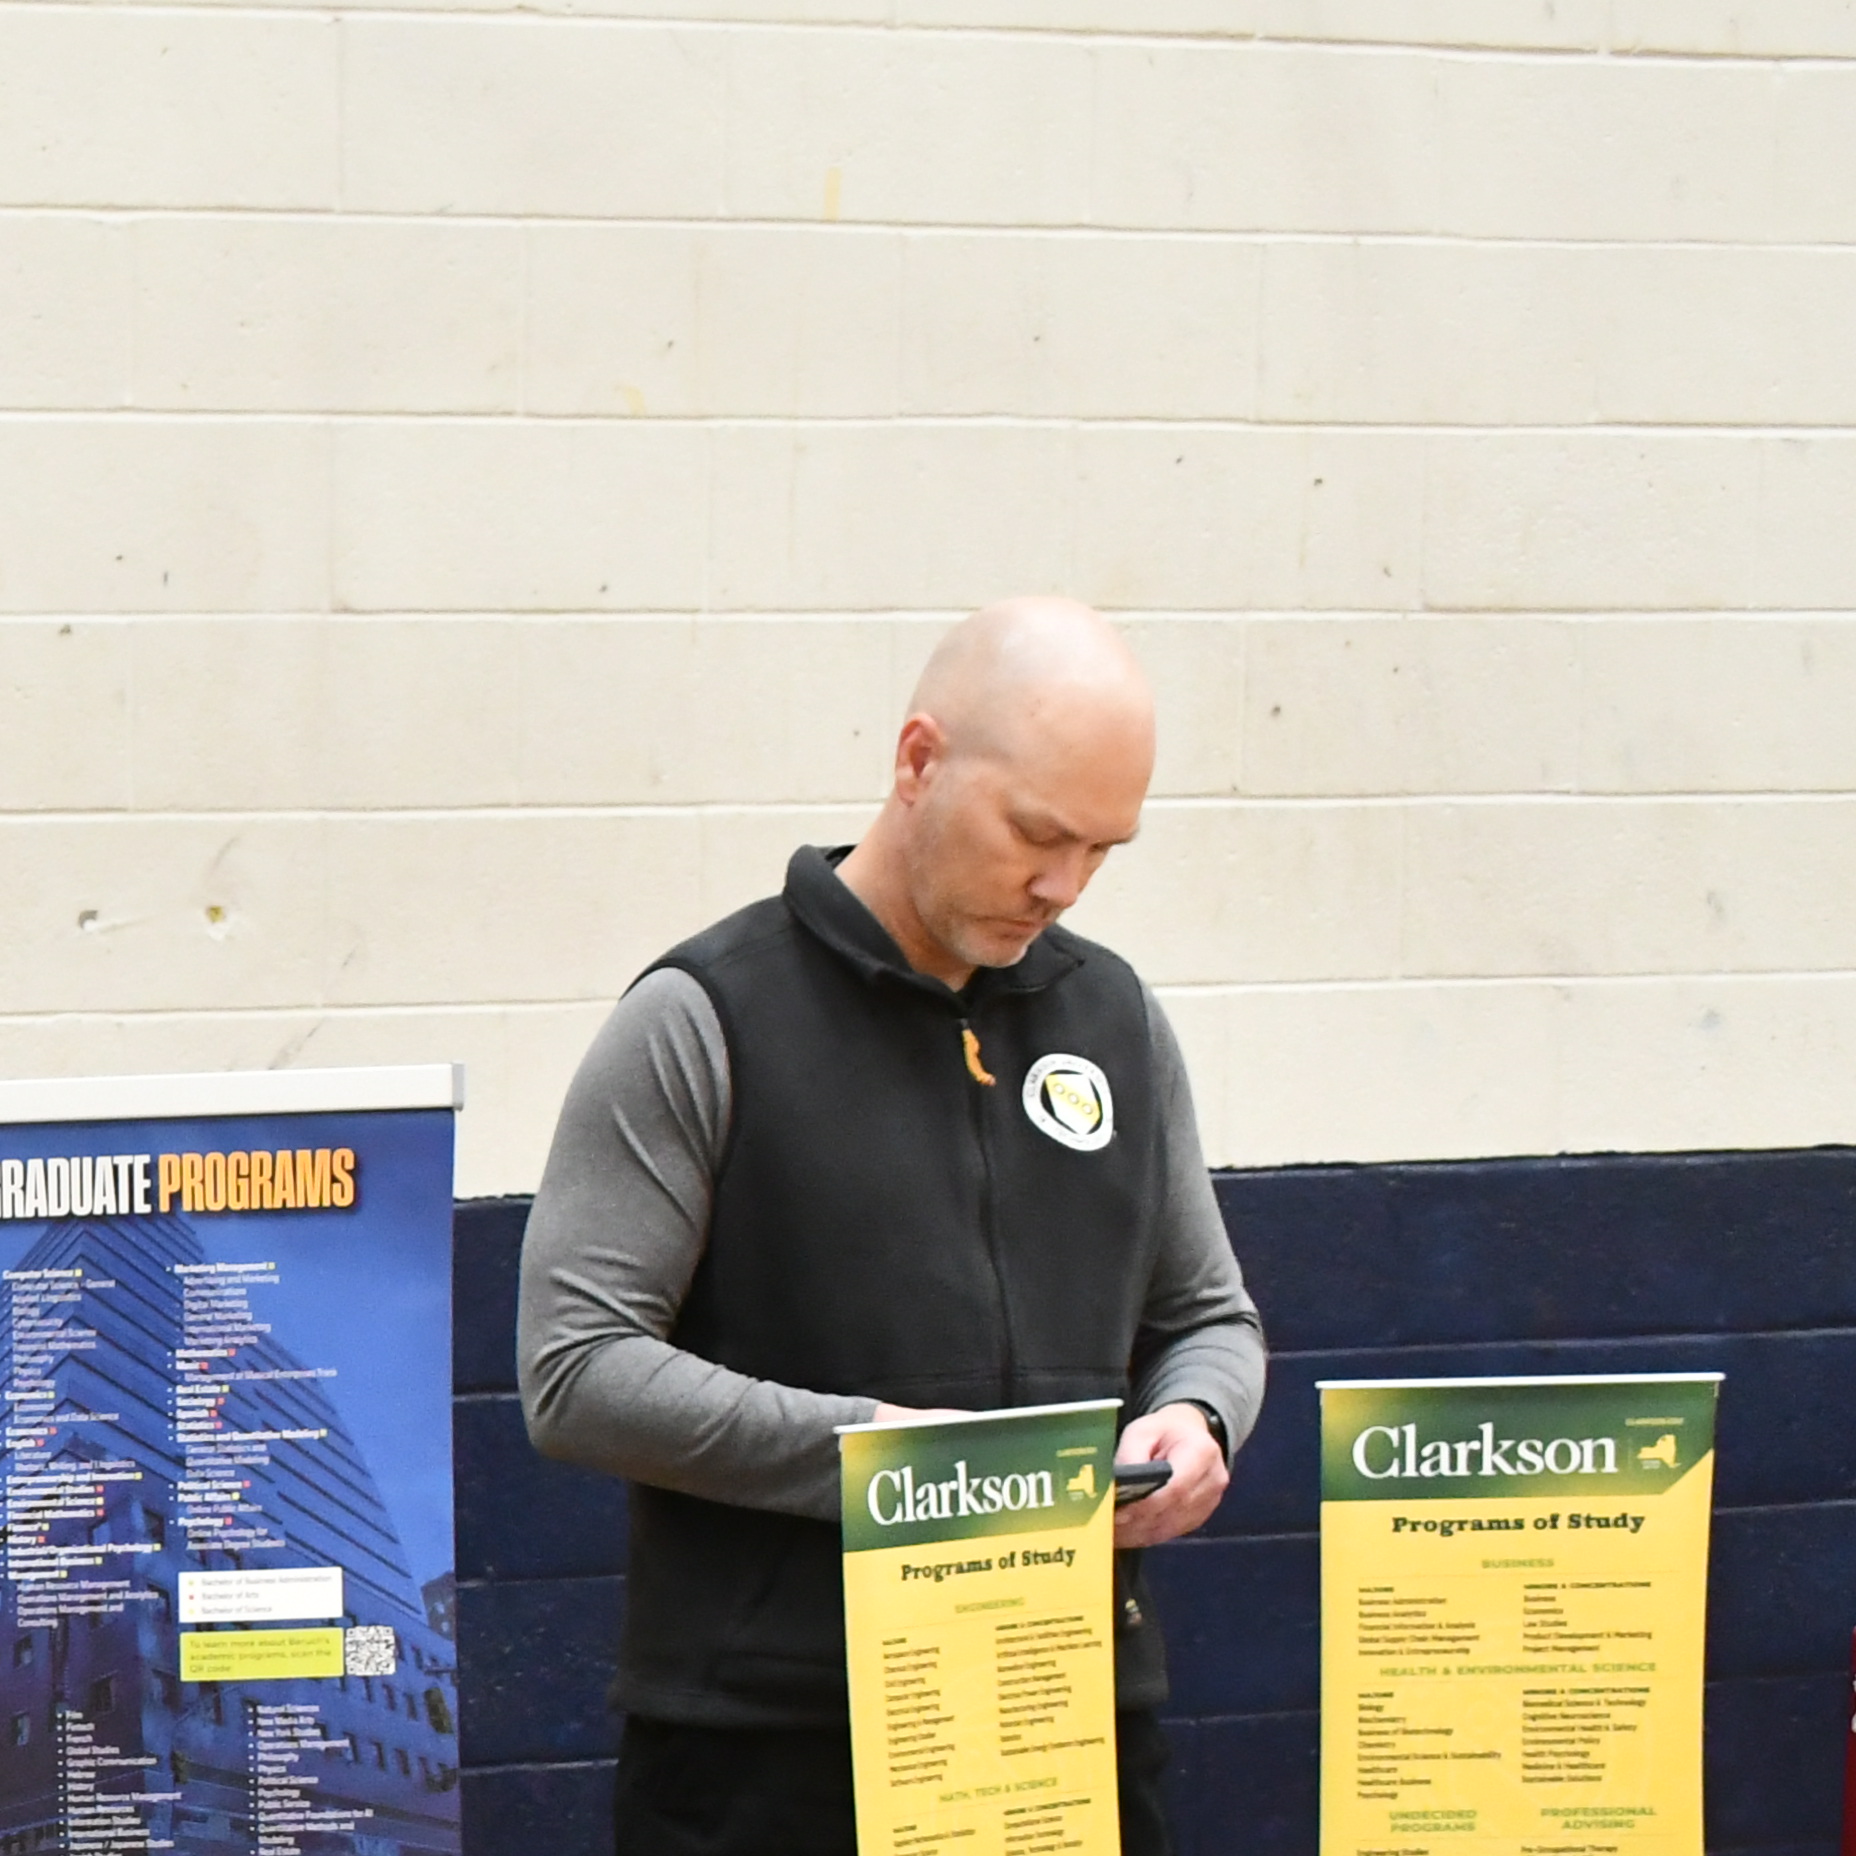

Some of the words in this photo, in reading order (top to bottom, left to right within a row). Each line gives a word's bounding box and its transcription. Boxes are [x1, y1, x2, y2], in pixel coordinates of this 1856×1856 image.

[158, 1147, 355, 1214] PROGRAMS
[1352, 1421, 1619, 1479] Clarkson
[867, 1460, 1055, 1525] Clarkson
[1392, 1516, 1525, 1537] Programs
[1533, 1513, 1560, 1530] of
[1568, 1512, 1645, 1534] Study
[901, 1558, 993, 1582] Programs
[999, 1551, 1016, 1570] of
[1022, 1546, 1076, 1567] Study
